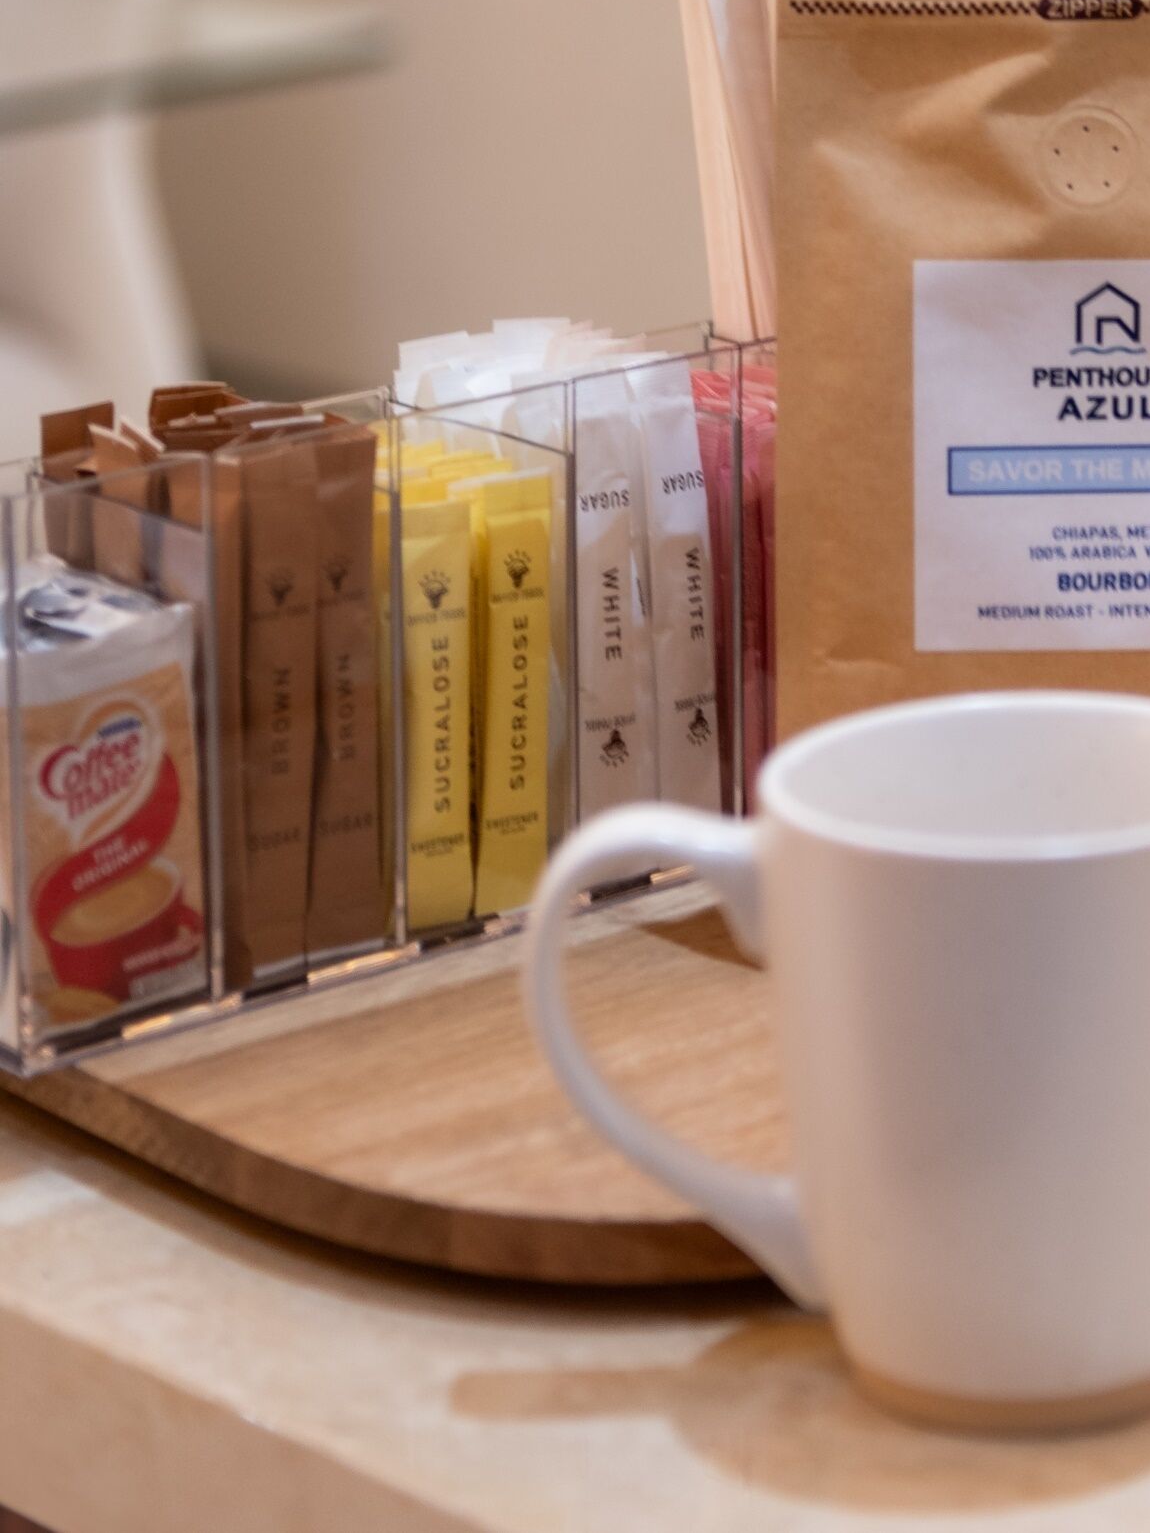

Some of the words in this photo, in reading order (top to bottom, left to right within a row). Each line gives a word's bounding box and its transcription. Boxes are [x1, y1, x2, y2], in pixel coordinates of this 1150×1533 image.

[662, 469, 705, 495] SUGAR
[967, 459, 1064, 483] SAVOR
[1071, 458, 1124, 481] THE
[580, 489, 630, 512] SUGAR
[1029, 546, 1066, 561] 100%
[1071, 545, 1137, 560] ARABICA
[1052, 526, 1122, 542] CHIAPAS,
[602, 567, 622, 661] WHITE
[686, 548, 704, 641] WHITE
[977, 605, 1041, 619] MEDIUM
[1045, 604, 1094, 619] ROAST
[271, 667, 292, 774] BROWN
[338, 655, 355, 759] BROWN
[431, 635, 452, 814] SUCRALOSE
[509, 616, 529, 791] SUCRALOSE
